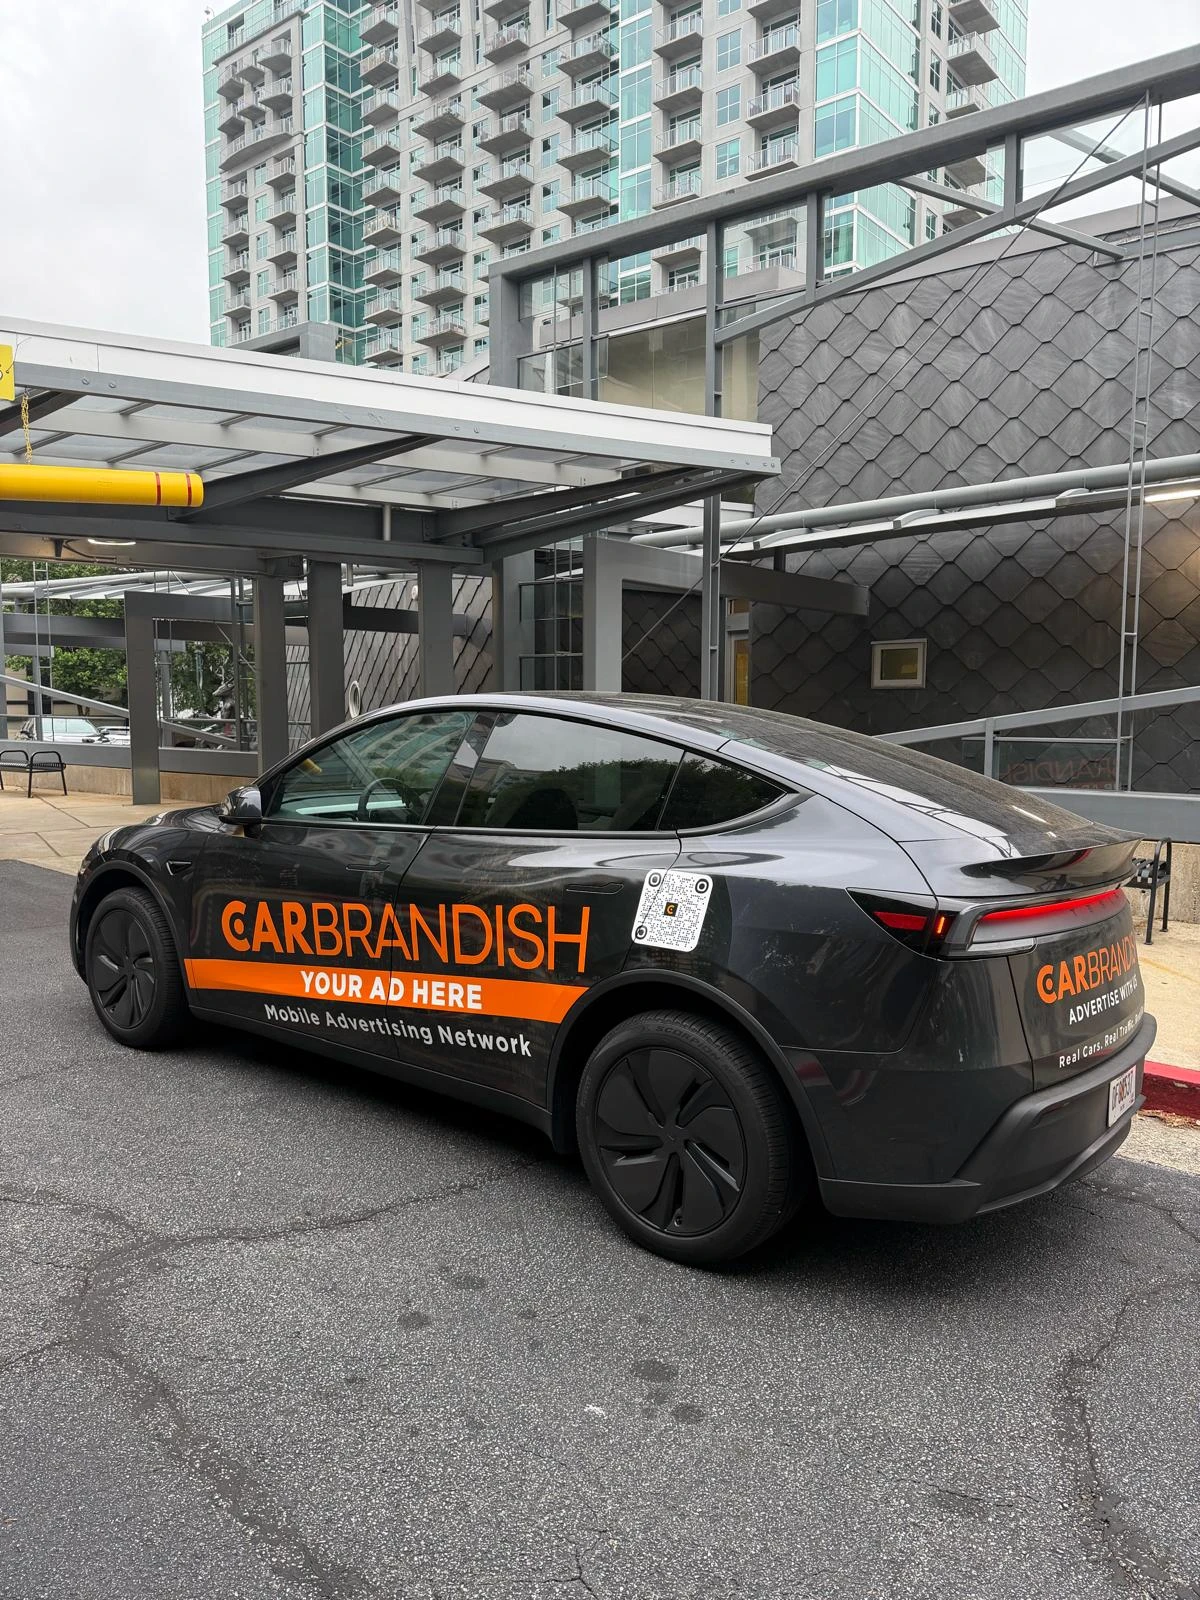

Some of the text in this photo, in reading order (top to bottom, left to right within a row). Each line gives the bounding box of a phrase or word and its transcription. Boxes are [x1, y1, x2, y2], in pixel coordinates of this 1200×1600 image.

[221, 900, 591, 973] CARBRANDISH
[300, 969, 483, 1010] YOUR AD HERE
[1069, 990, 1120, 1025] ADVERTISE
[264, 1004, 532, 1057] Mobile Advertising Network
[1059, 1050, 1080, 1068] Real
[1104, 1032, 1119, 1047] Real
